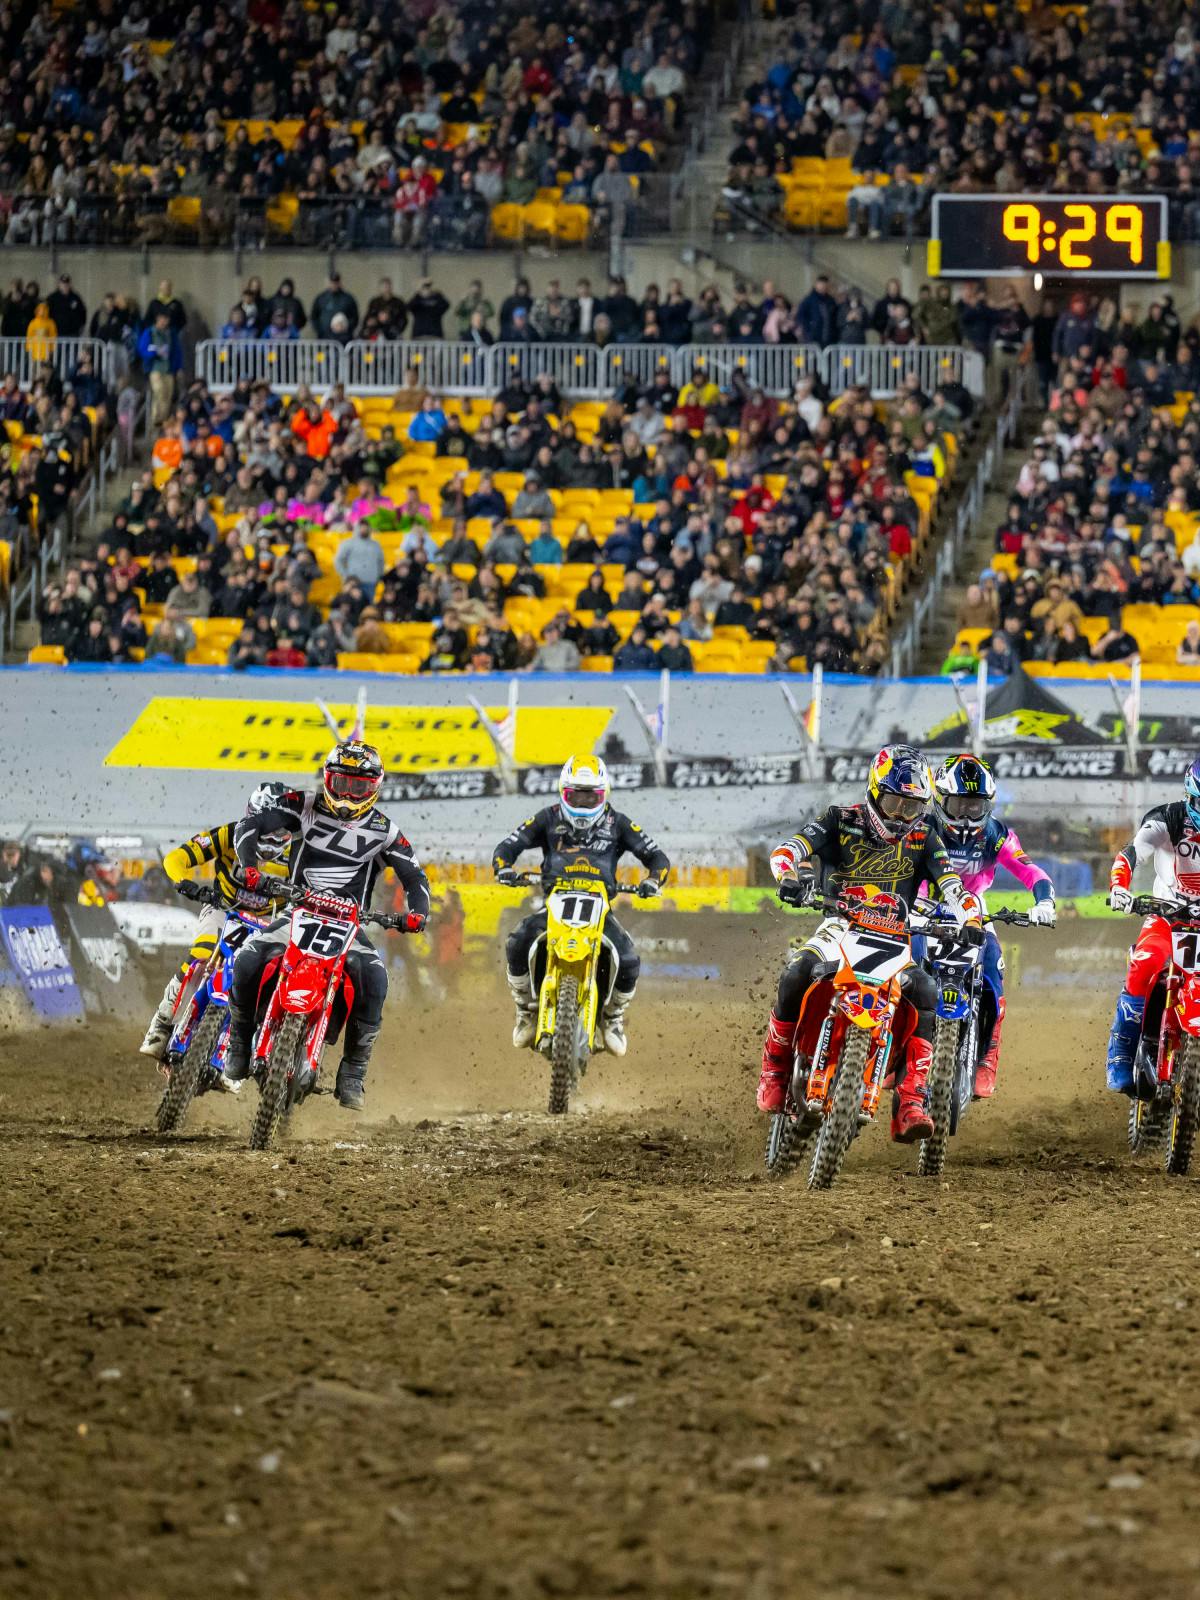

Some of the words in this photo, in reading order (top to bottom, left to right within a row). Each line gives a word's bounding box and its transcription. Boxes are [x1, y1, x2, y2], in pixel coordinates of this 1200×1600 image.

[1003, 204, 1143, 268] 9:29
[305, 820, 386, 858] FLY
[850, 844, 915, 876] Thor
[561, 897, 595, 921] 11
[298, 922, 349, 957] 15
[852, 936, 906, 974] 7
